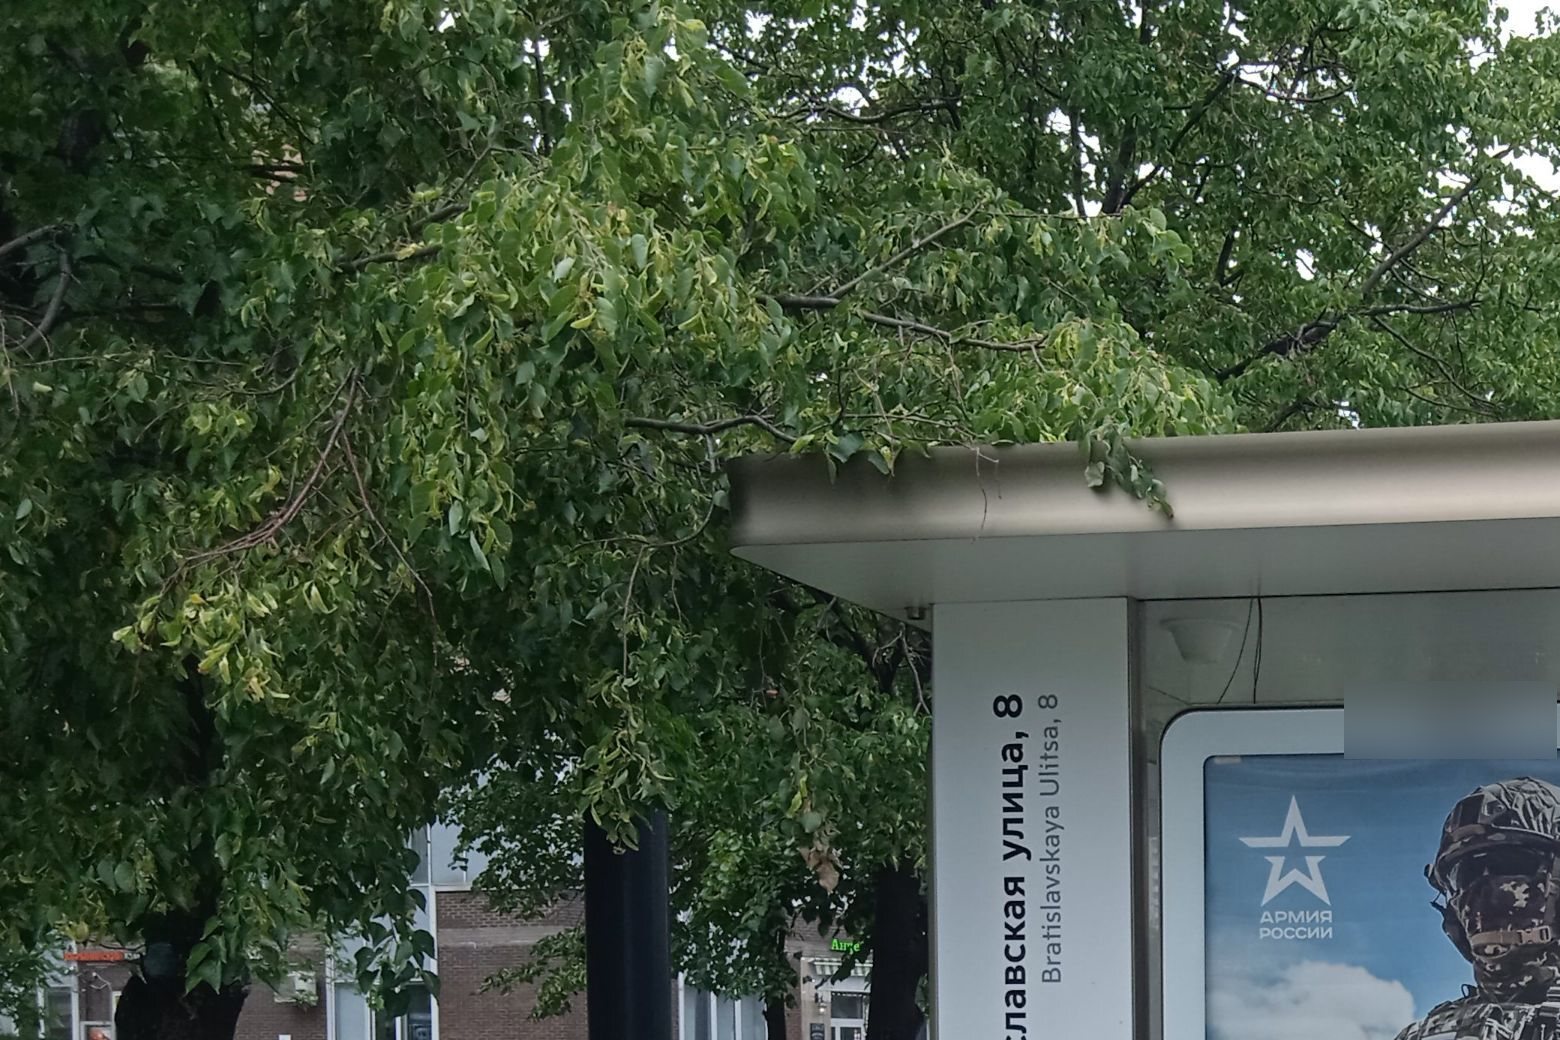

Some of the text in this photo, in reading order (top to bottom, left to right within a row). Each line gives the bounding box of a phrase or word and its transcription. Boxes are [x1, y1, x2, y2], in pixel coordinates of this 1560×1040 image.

[993, 694, 1023, 718] 8
[1001, 731, 1031, 861] улица,
[1038, 694, 1065, 984] Bratislavskaya Ulitsa, 8
[1260, 910, 1333, 924] АРМИЯ
[1259, 927, 1333, 940] РОССИИ
